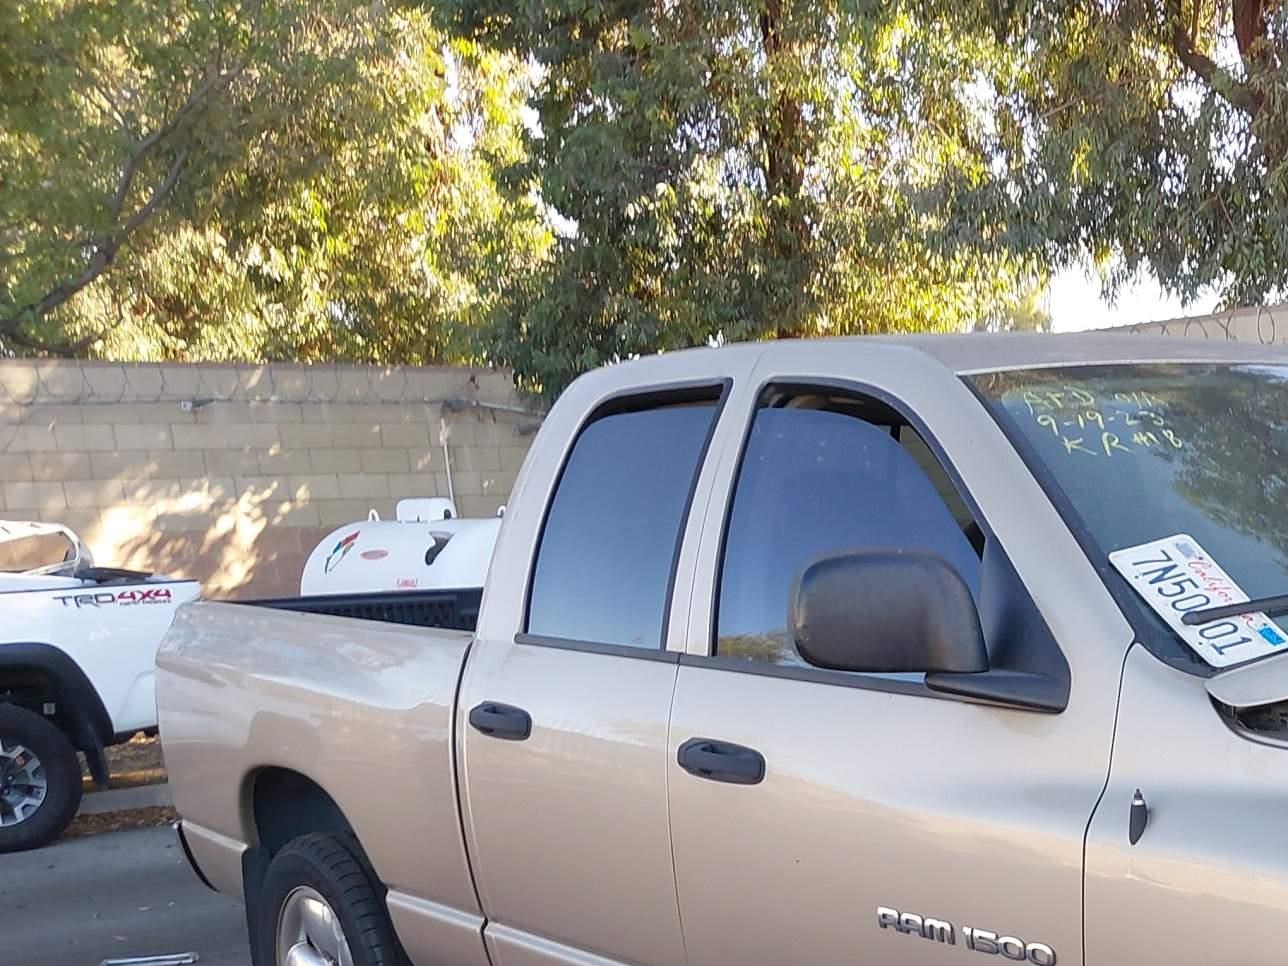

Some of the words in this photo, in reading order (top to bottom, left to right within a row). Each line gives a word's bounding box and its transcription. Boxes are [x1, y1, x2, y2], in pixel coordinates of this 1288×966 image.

[52, 593, 116, 609] TRD
[1132, 549, 1254, 656] 7N5001
[876, 905, 956, 946] RAM
